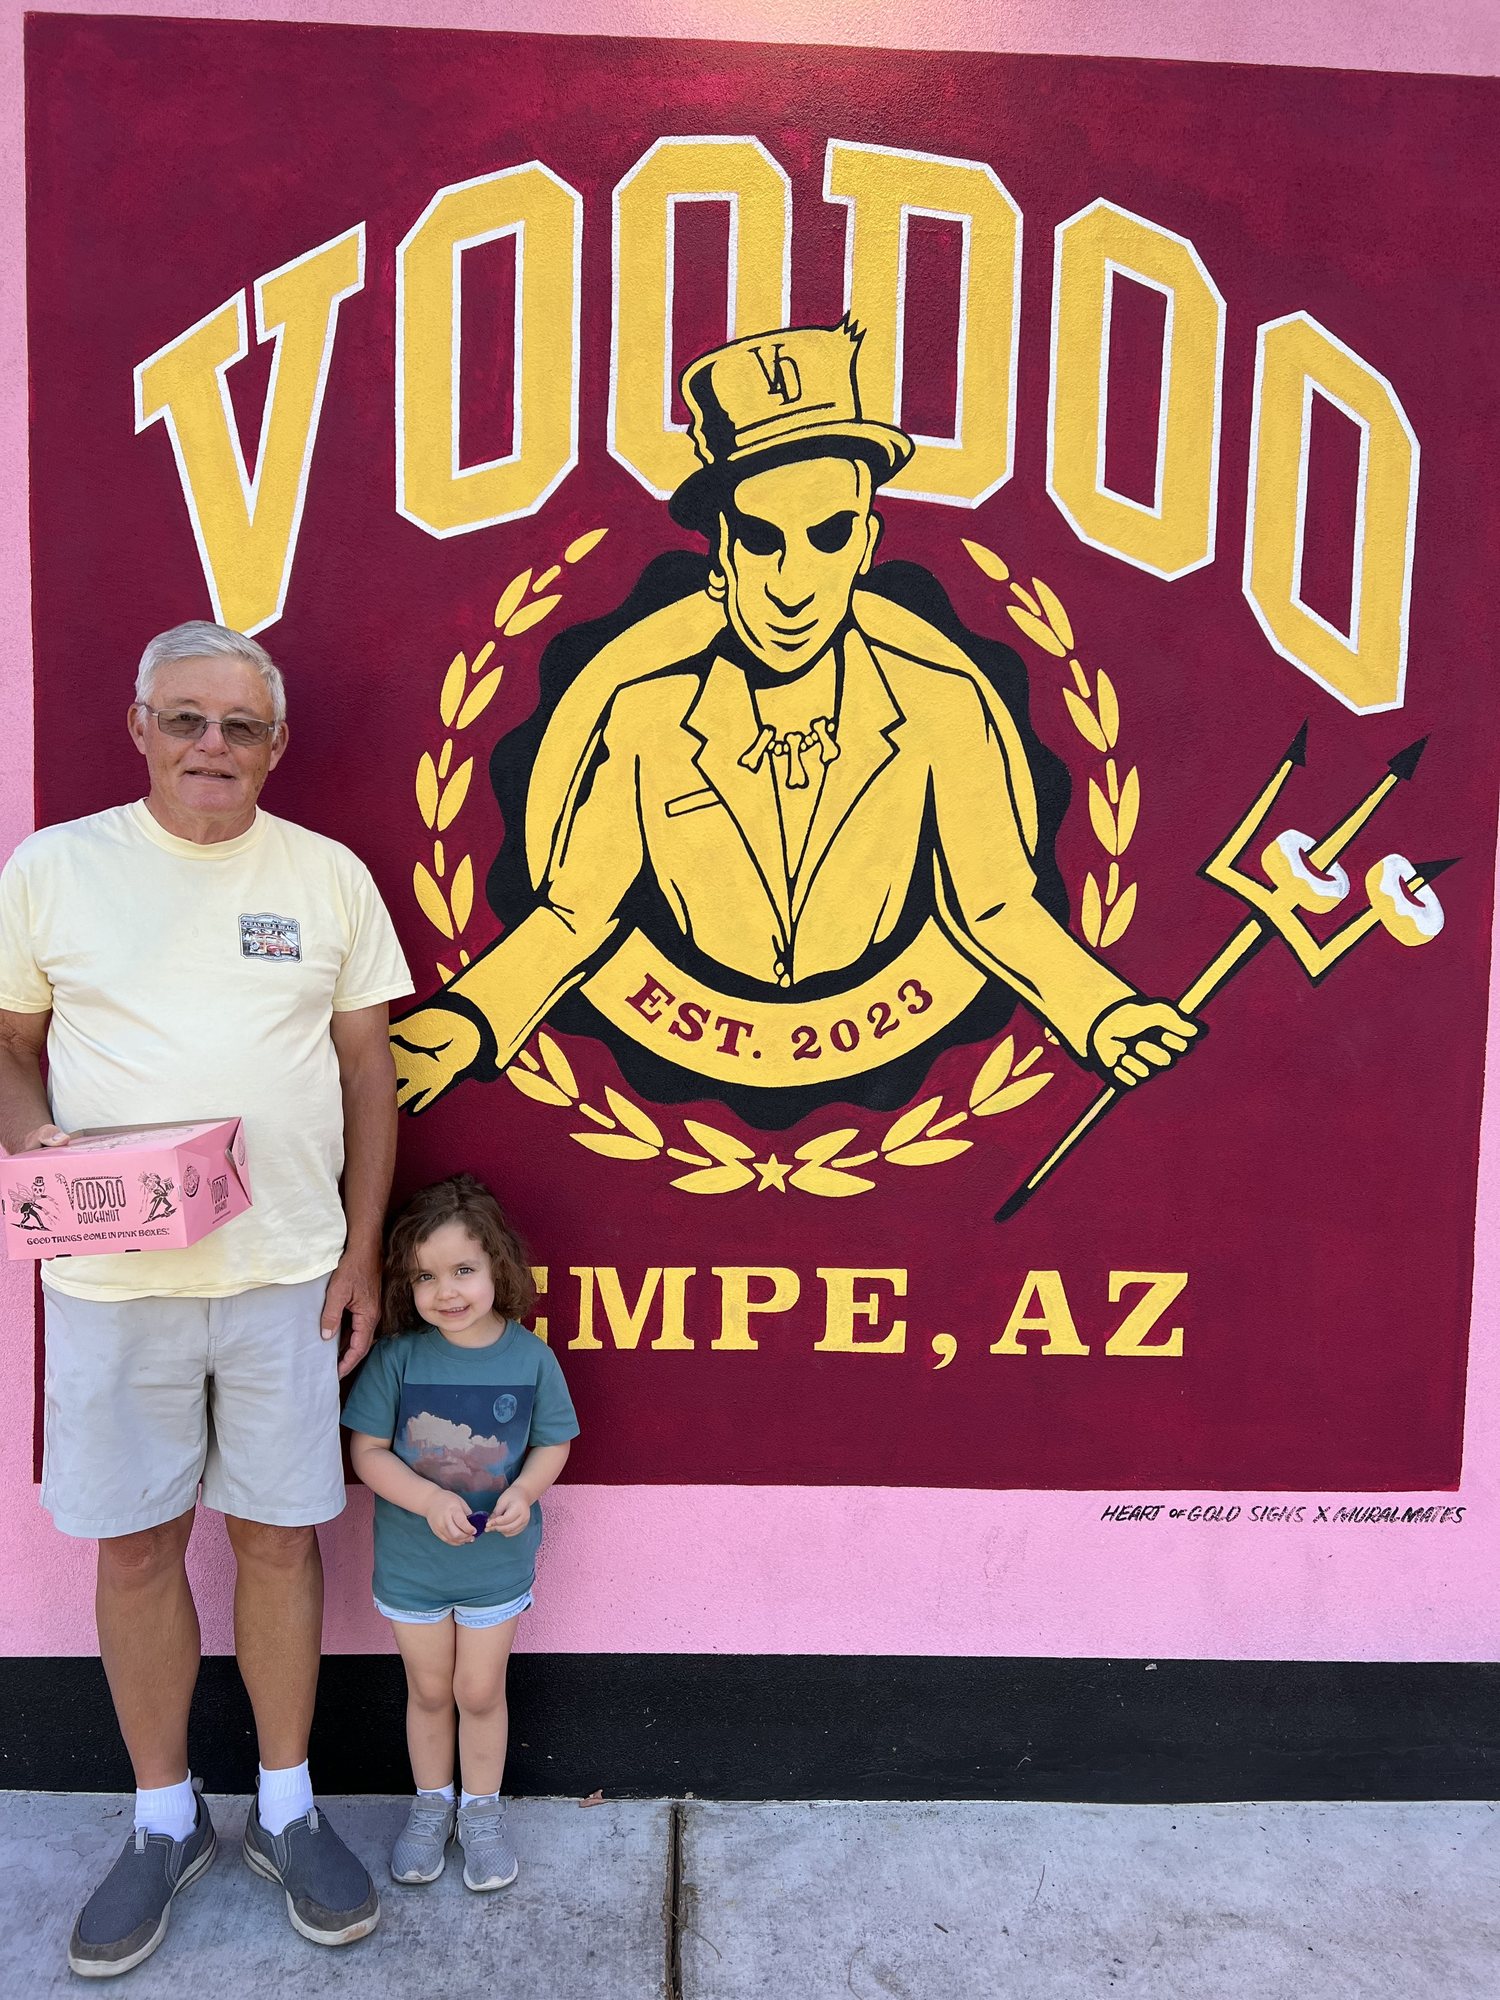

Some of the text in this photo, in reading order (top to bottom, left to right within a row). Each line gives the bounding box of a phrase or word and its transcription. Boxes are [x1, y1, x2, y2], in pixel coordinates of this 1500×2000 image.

[132, 134, 1421, 715] VOODOO
[624, 973, 933, 1061] EST. 2023
[55, 1172, 127, 1211] VOODOO
[77, 1209, 120, 1224] DOUGHNUT
[26, 1237, 51, 1246] GOOD
[51, 1234, 83, 1244] THINGS
[83, 1232, 107, 1241] COME
[107, 1231, 117, 1239] IN
[117, 1230, 138, 1239] PINK
[989, 1269, 1189, 1357] AZ
[1100, 1504, 1165, 1522] HEART
[1187, 1505, 1242, 1522] GOLD
[1247, 1505, 1307, 1523] SIGNS
[1312, 1505, 1331, 1524] X
